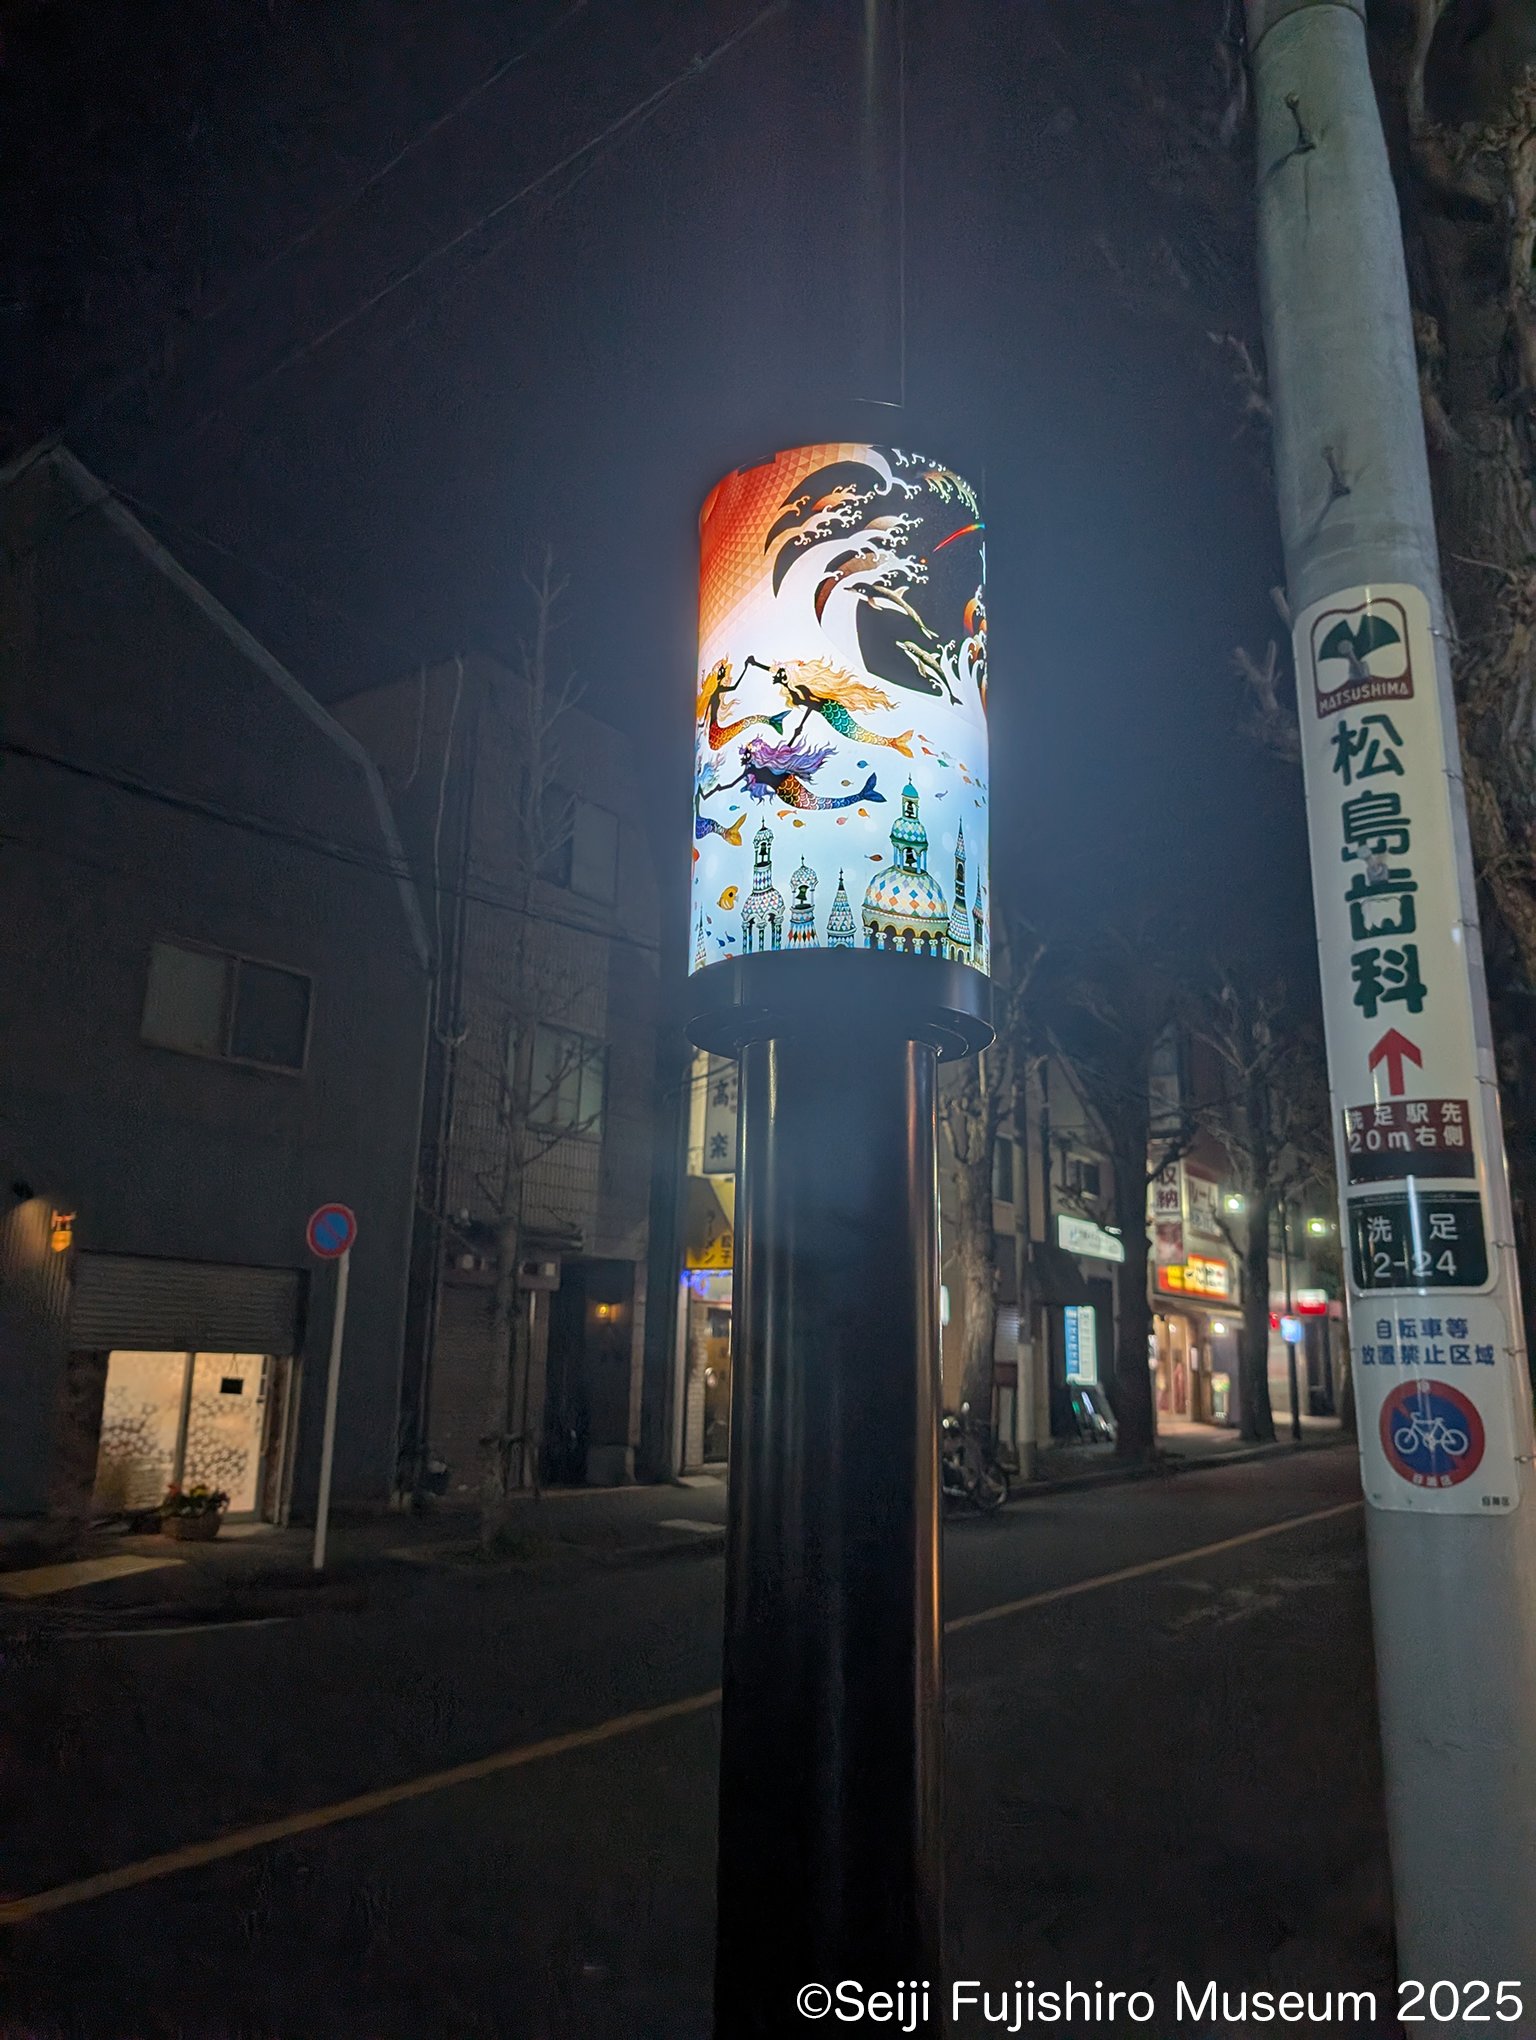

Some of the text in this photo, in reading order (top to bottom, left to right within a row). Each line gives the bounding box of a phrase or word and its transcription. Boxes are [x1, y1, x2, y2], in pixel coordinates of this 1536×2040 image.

[1319, 682, 1409, 713] MATSUSHIMA
[1332, 713, 1428, 1019] 松島歯科
[1350, 1125, 1463, 1153] 20m右側
[1367, 1213, 1458, 1242] 洗足
[1373, 1250, 1457, 1278] 2-24
[1376, 1317, 1469, 1339] 自転車等
[1361, 1343, 1495, 1366] 放置禁止区域
